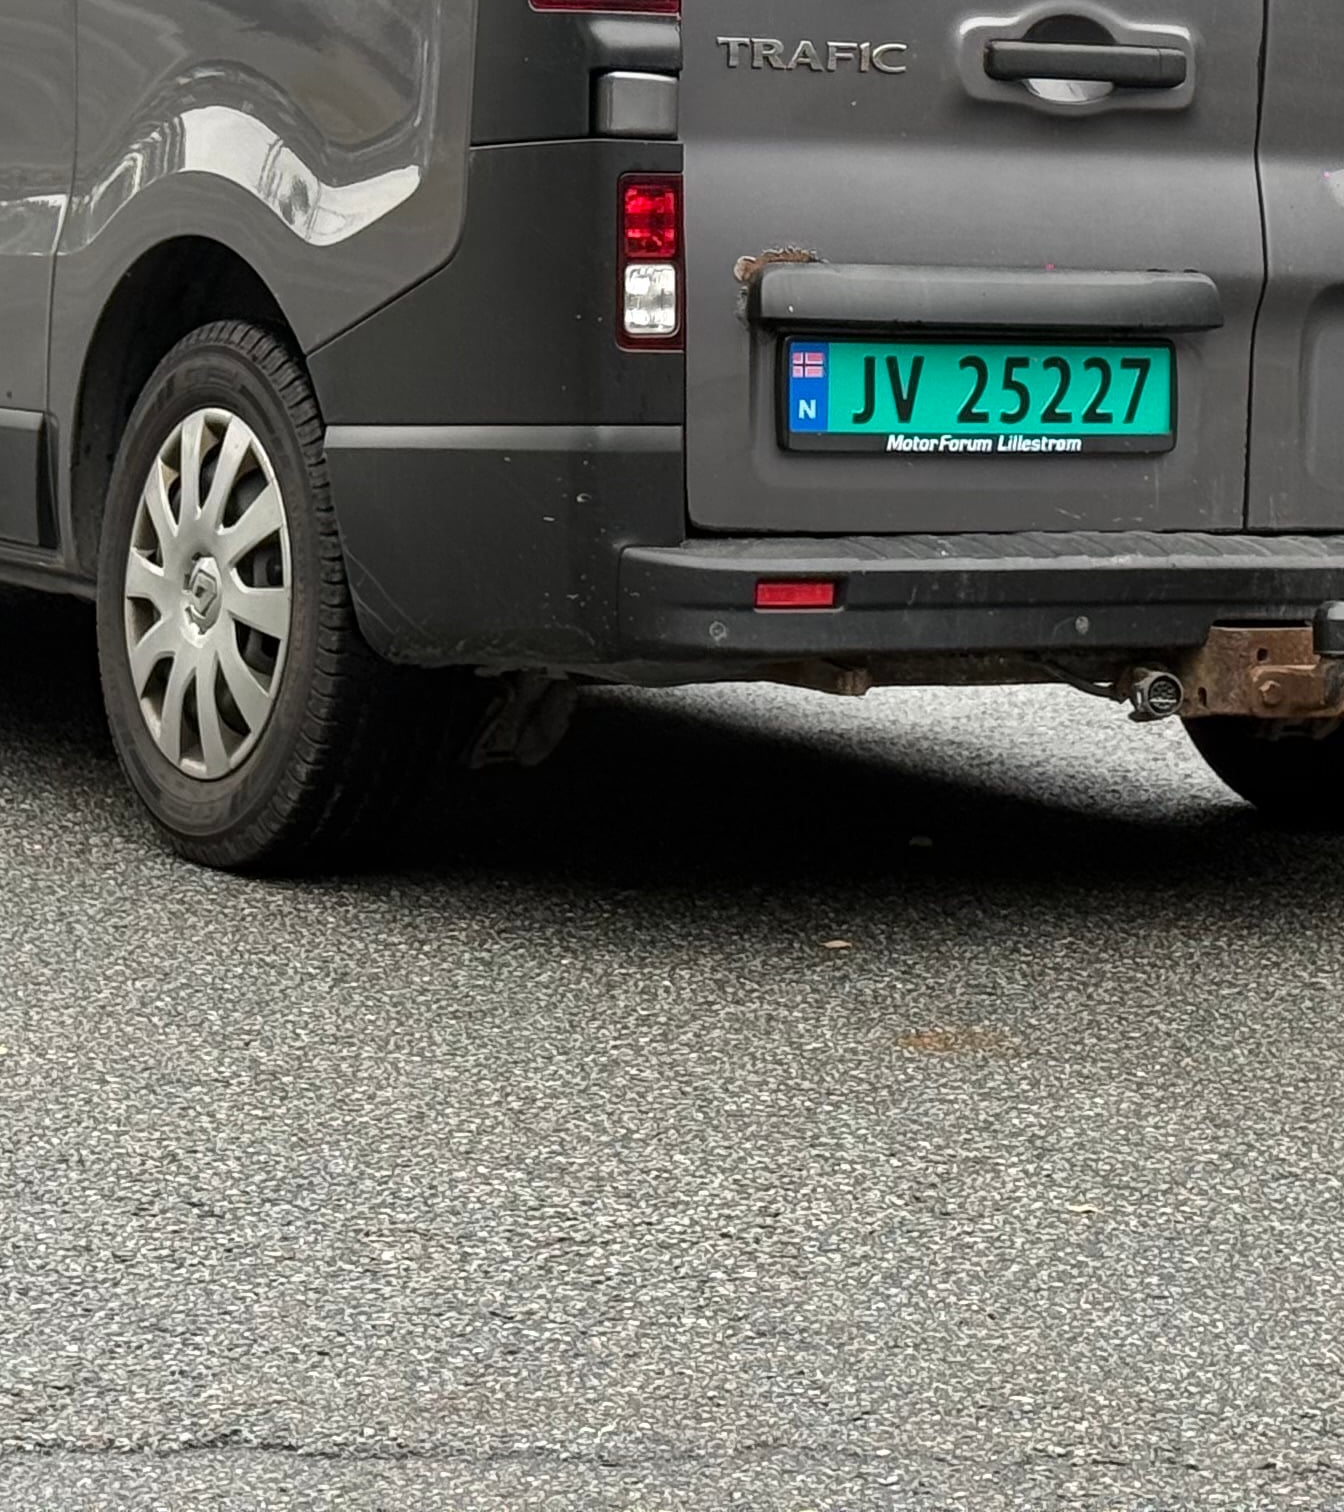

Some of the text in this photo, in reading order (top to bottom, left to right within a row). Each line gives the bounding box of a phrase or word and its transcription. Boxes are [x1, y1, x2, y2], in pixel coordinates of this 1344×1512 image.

[716, 36, 907, 73] TRAFIC
[852, 355, 1151, 425] JV 25227
[798, 399, 816, 419] N
[886, 434, 993, 453] MotorForum
